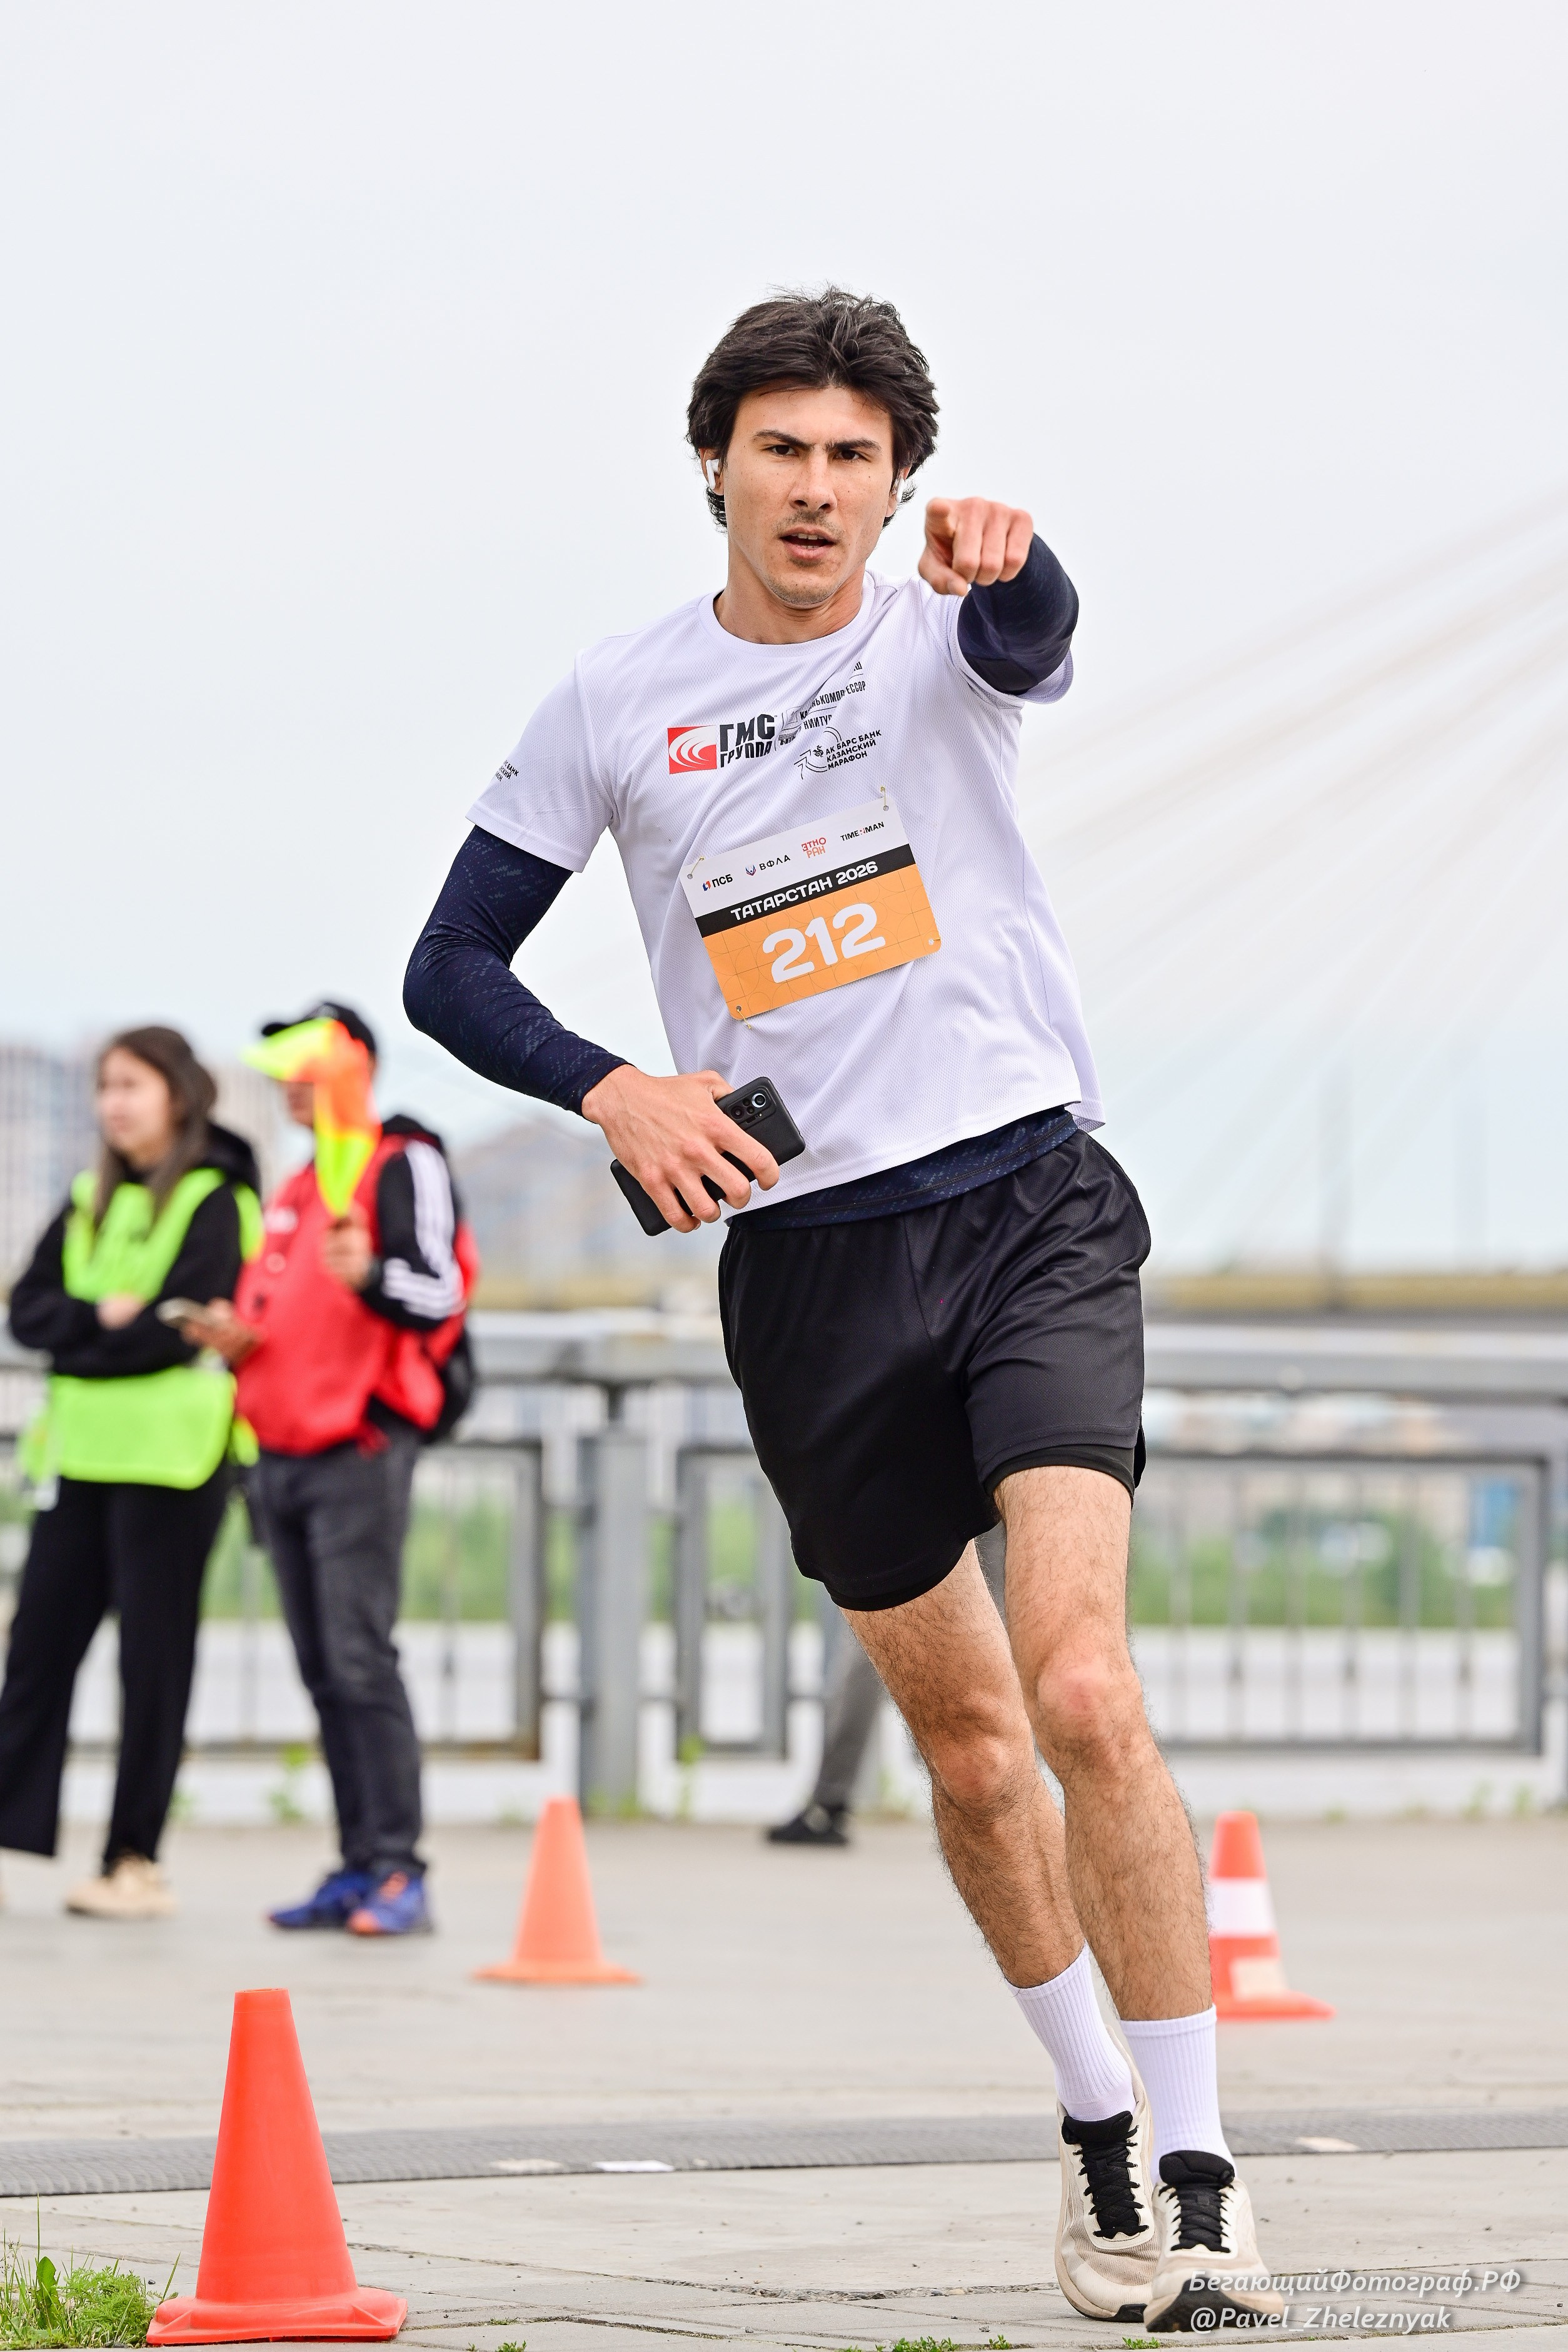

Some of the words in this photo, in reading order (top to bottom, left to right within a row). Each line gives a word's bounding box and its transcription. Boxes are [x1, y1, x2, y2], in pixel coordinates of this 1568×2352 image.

[720, 714, 775, 752] ГМС
[825, 745, 835, 755] АК
[837, 737, 857, 750] БАРС
[858, 729, 882, 742] БАНК
[720, 740, 773, 768] ГРУППА
[827, 737, 877, 763] КАЗАНСКИЙ
[827, 750, 868, 770] МАРАФОН
[758, 854, 791, 871] ВФЛА
[807, 845, 826, 859] РАН
[711, 874, 733, 888] ПСБ
[730, 876, 833, 921] ТАТАРСТАН
[836, 861, 878, 886] 2026
[762, 902, 886, 984] 212
